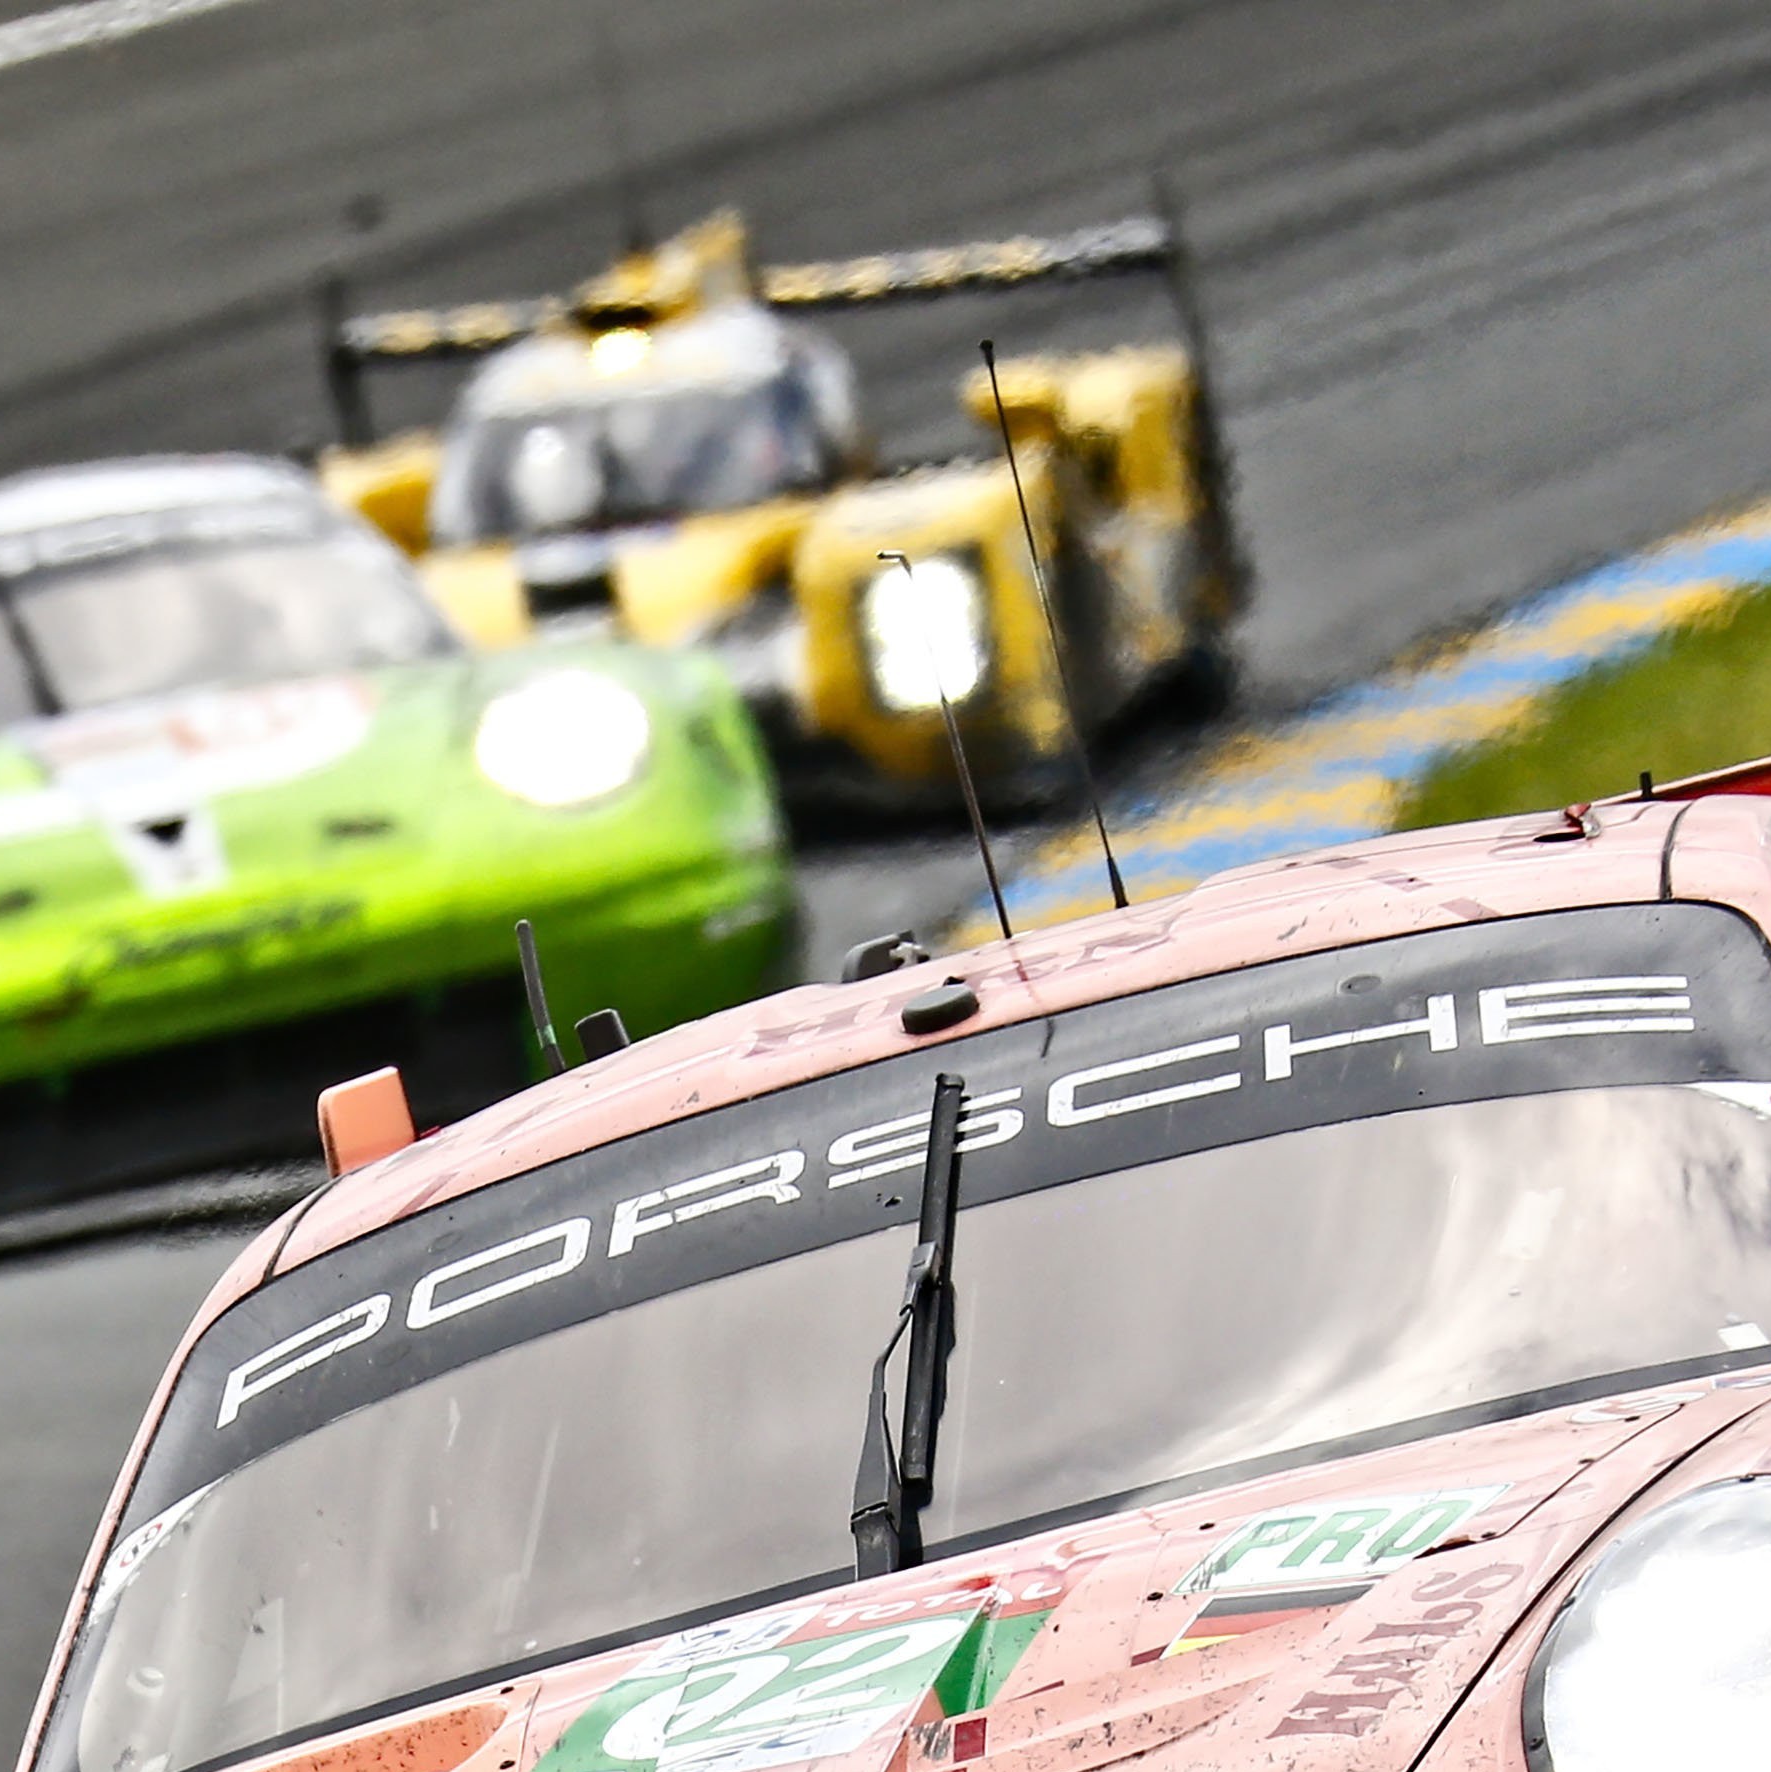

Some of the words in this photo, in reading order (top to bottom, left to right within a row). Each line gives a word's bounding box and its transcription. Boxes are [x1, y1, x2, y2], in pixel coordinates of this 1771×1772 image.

[217, 972, 1696, 1430] PORSCHE
[1223, 1498, 1473, 1573] PRO
[821, 1581, 1062, 1628] TOTAL
